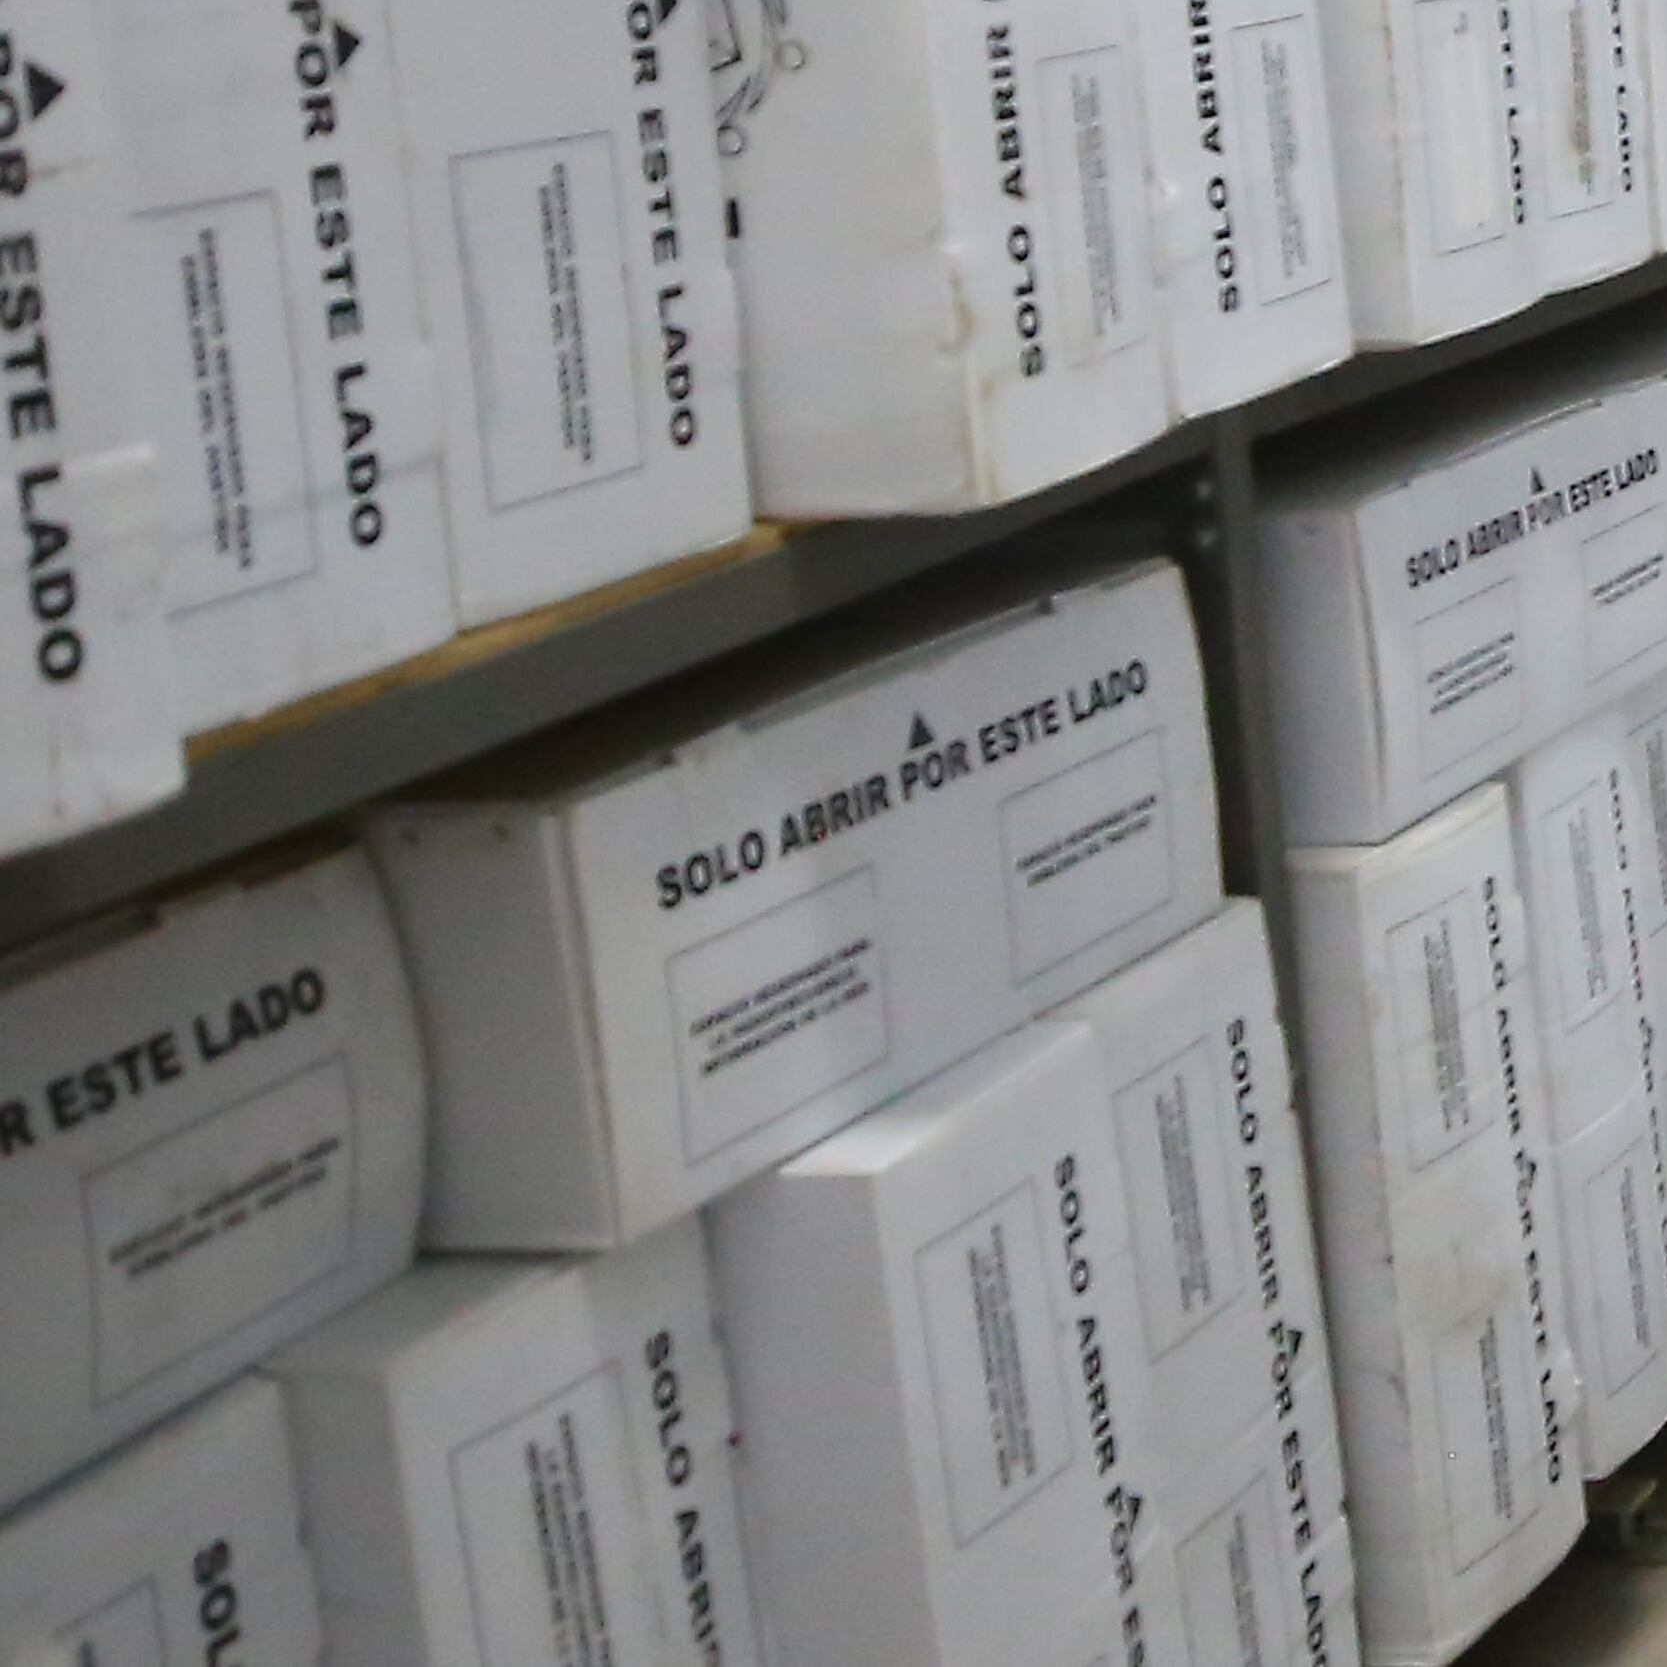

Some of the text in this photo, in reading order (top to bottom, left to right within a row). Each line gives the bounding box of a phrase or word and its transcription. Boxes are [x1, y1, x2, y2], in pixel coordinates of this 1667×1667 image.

[988, 26, 1025, 198] ABRIR
[638, 108, 677, 259] ESTE
[658, 286, 694, 447] LADO
[1008, 224, 1043, 376] SOLO
[1208, 175, 1238, 312] SOLO
[0, 235, 82, 683] ESTE LADO
[310, 164, 358, 337] ESTE
[335, 364, 382, 547] LADO
[657, 660, 1147, 909] SOLO ABRIR POR ESTE LADO
[48, 968, 325, 1129] ESTE LADO
